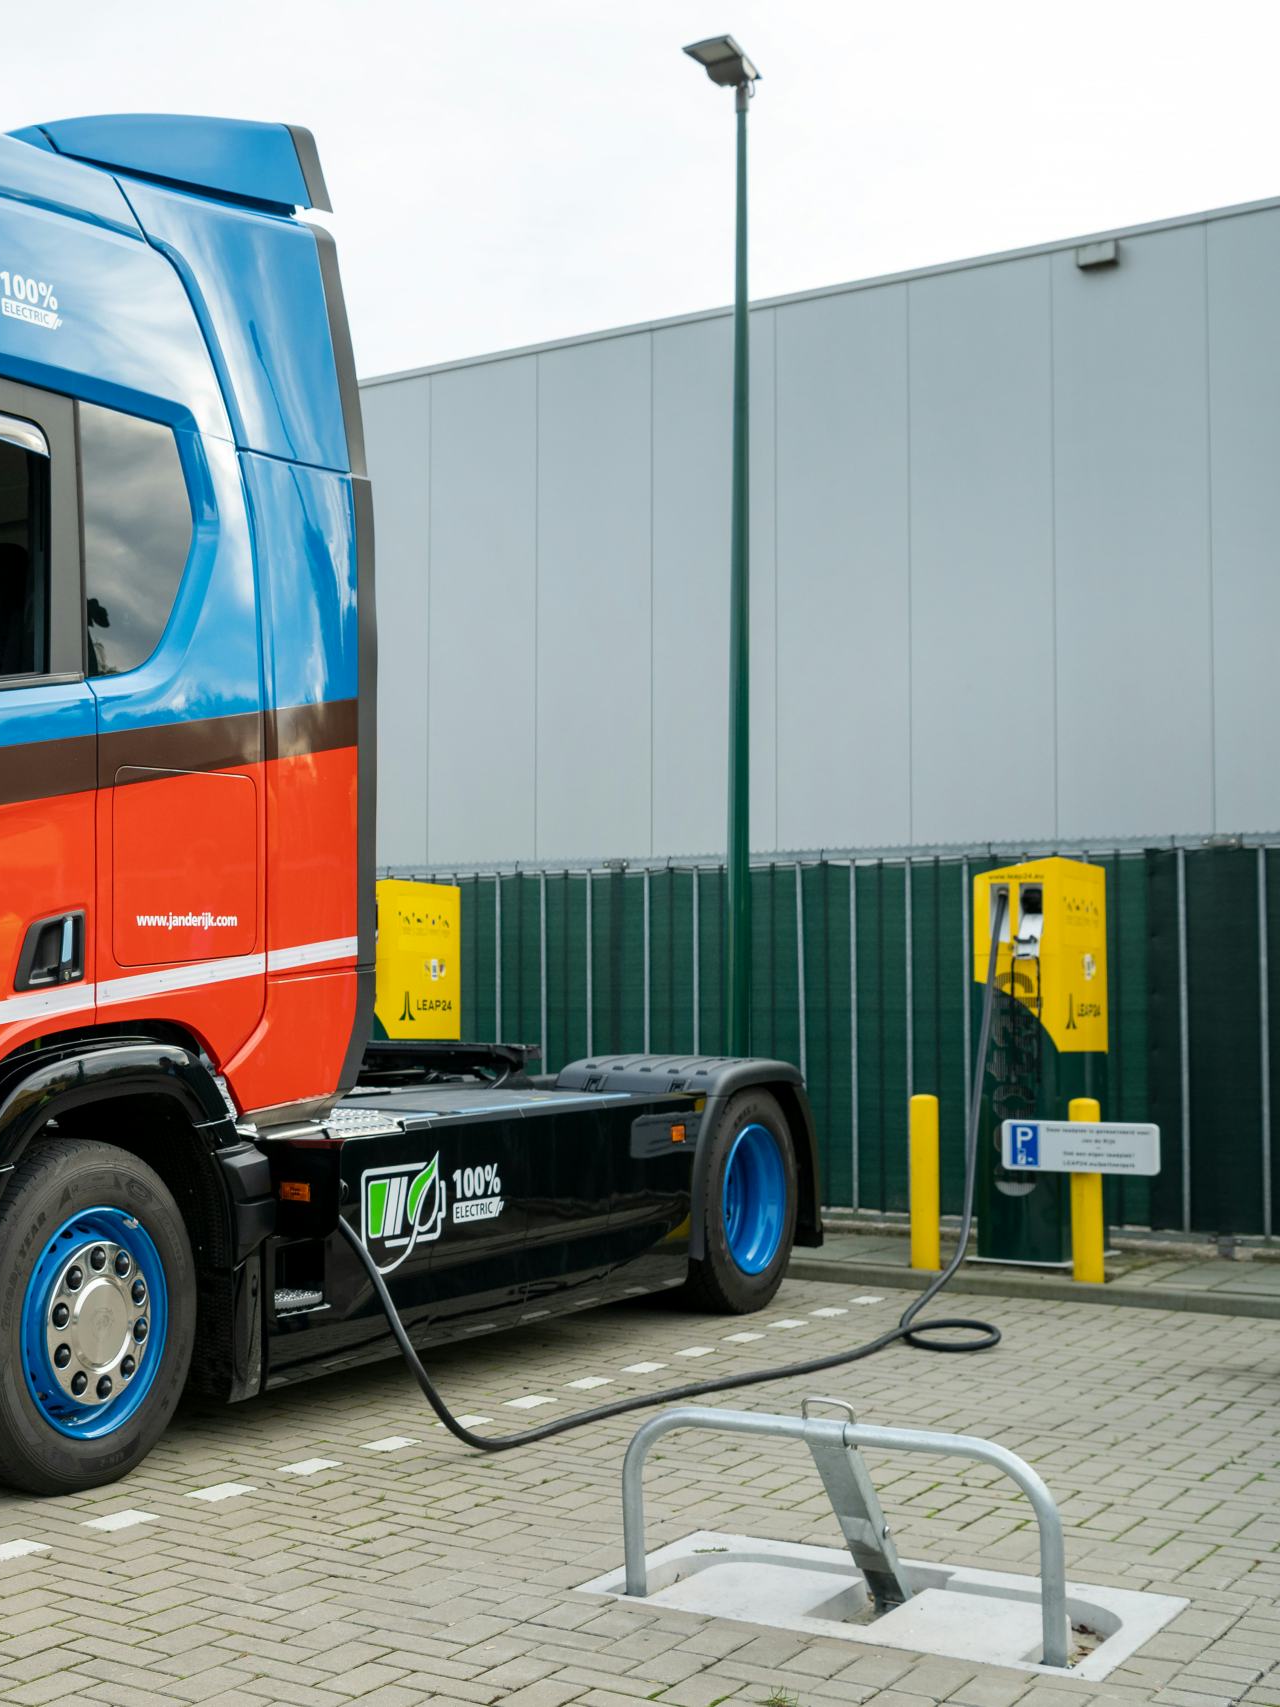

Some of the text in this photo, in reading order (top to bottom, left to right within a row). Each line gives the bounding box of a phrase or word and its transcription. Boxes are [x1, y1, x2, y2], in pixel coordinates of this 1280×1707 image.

[0, 271, 58, 310] 100%
[3, 302, 51, 325] ELECTRIC
[136, 912, 238, 930] www.janderijk.com
[416, 1000, 452, 1011] LEAP24
[453, 1162, 501, 1199] 100%
[455, 1202, 493, 1219] ELECTRIC
